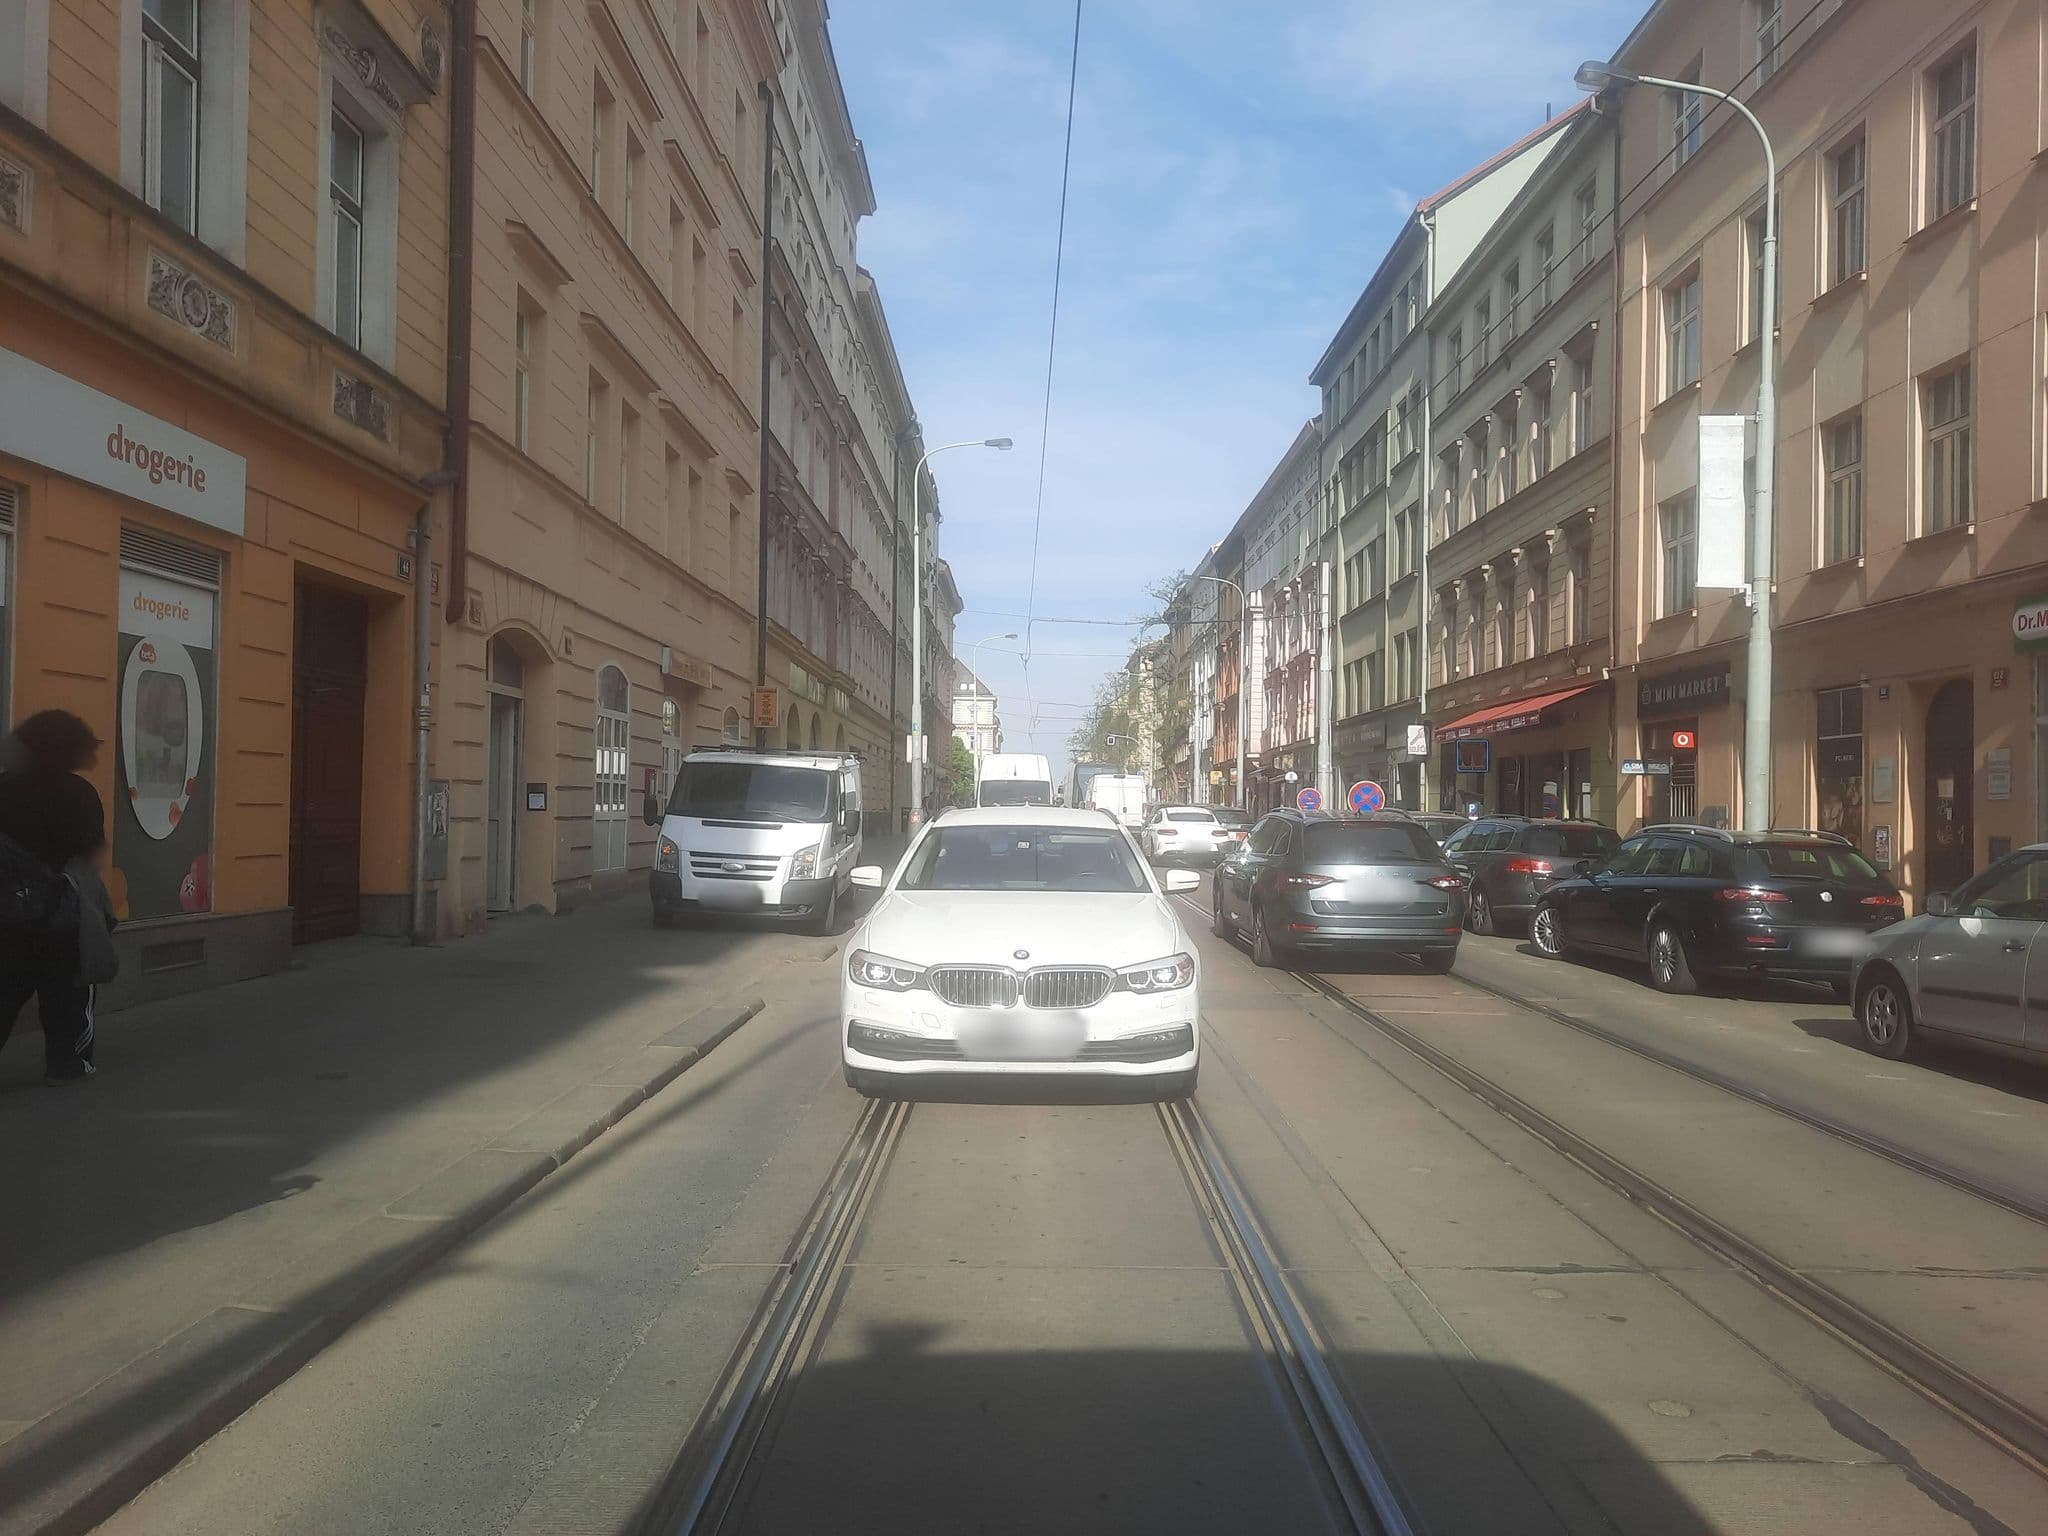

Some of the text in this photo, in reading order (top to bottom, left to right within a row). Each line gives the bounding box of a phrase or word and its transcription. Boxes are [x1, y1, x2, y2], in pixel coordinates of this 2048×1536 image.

[107, 423, 206, 493] drogerie
[133, 591, 190, 622] drogerie
[1654, 676, 1719, 704] MINI MARKET
[1468, 803, 1476, 813] P
